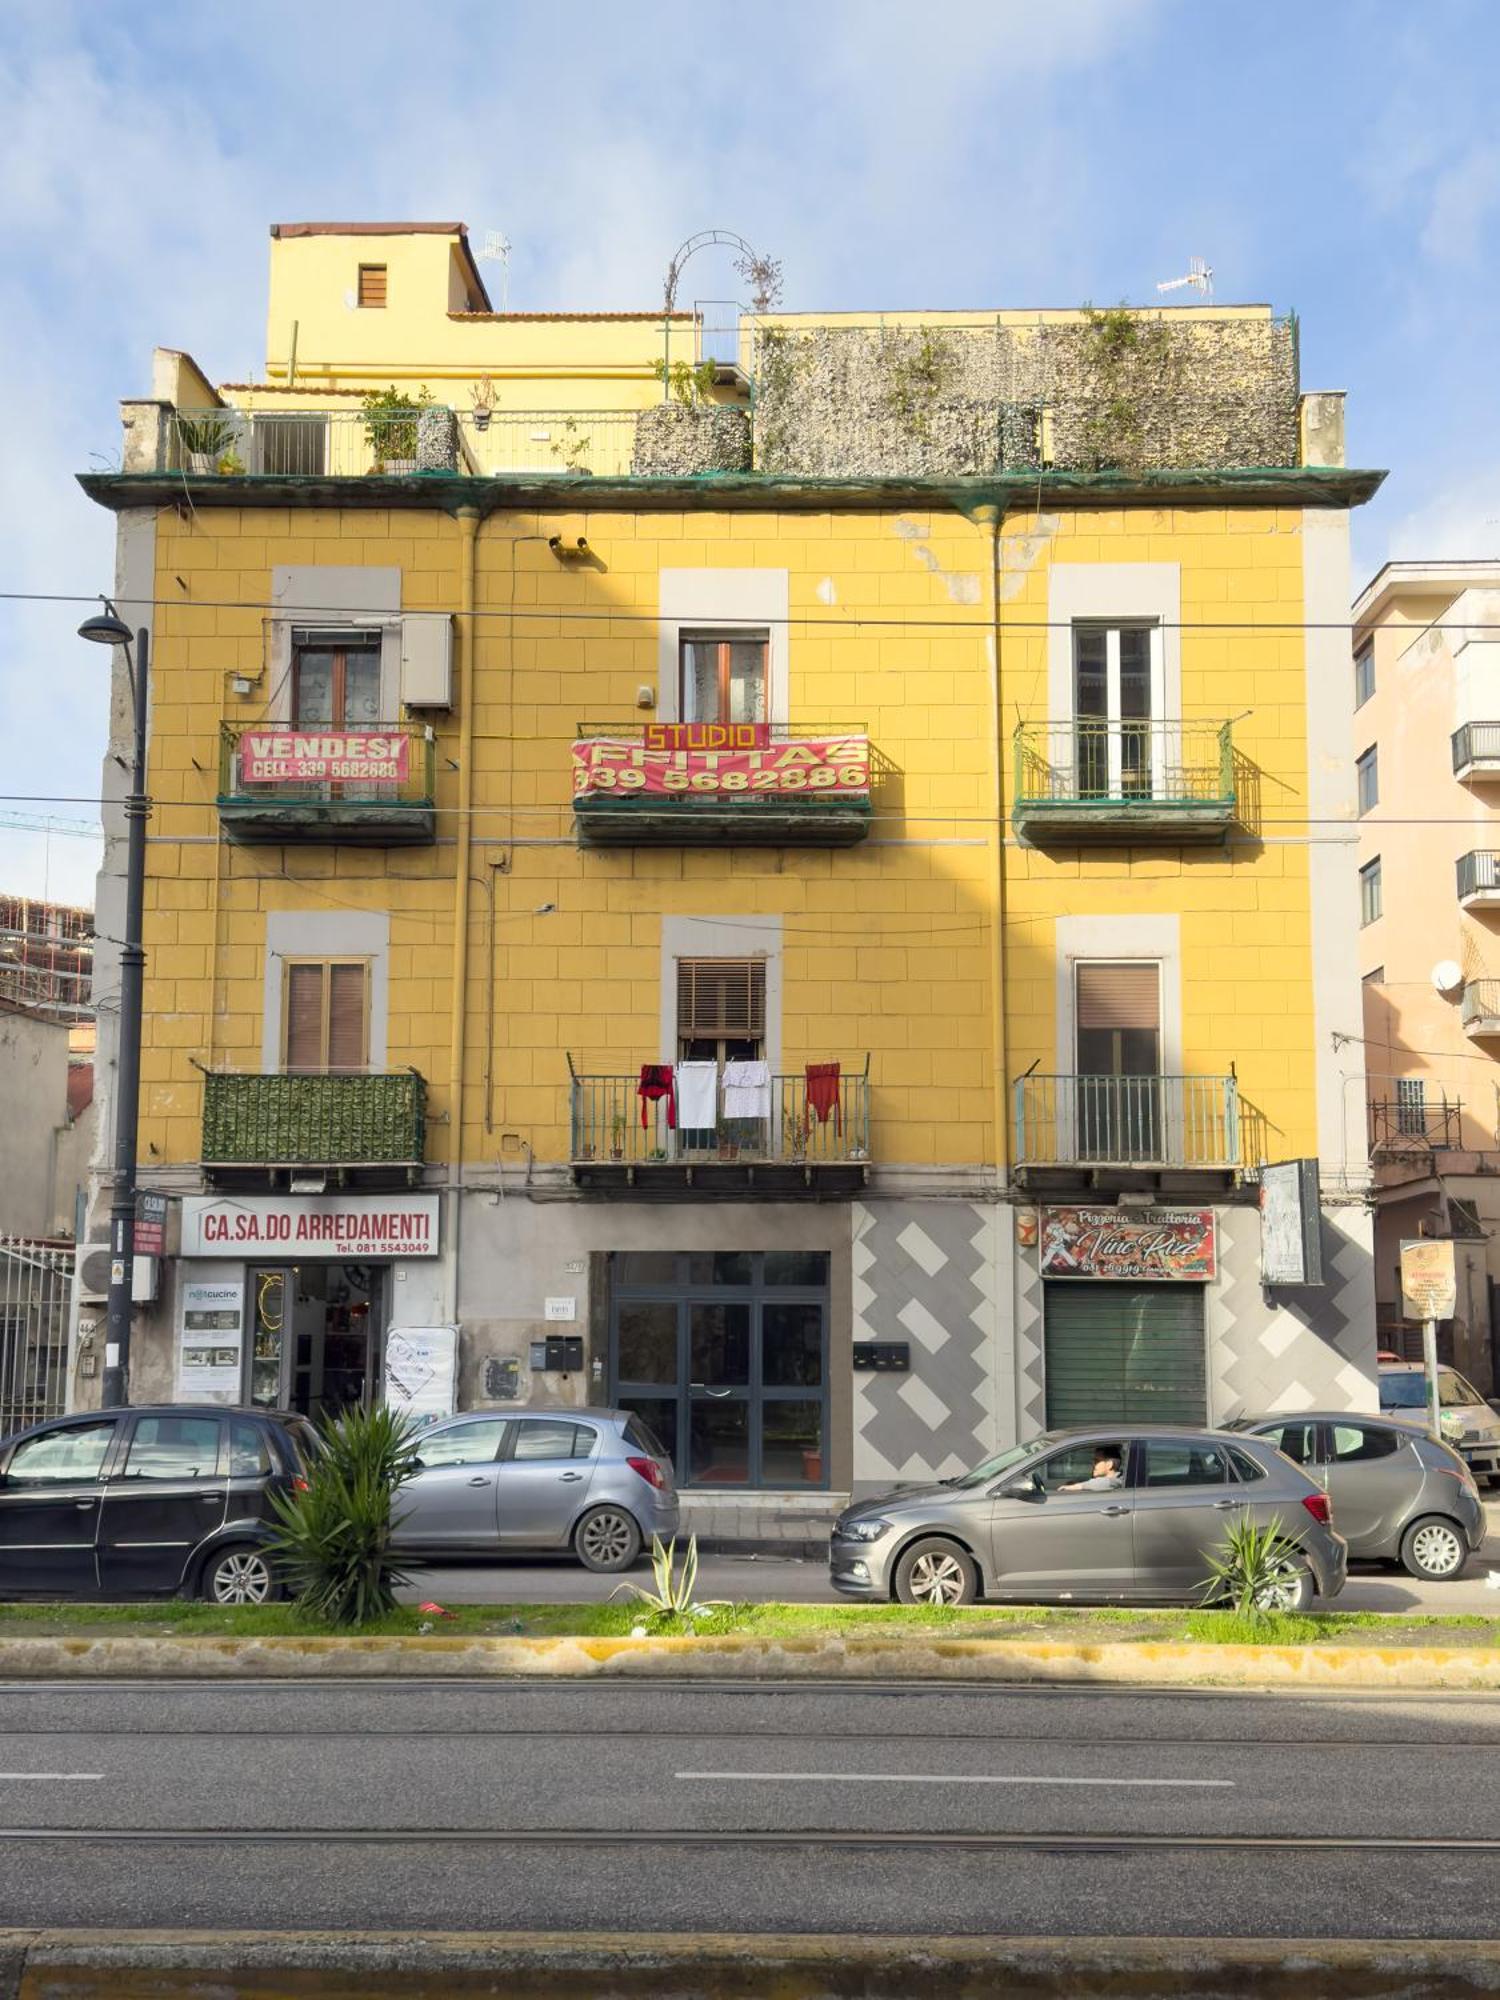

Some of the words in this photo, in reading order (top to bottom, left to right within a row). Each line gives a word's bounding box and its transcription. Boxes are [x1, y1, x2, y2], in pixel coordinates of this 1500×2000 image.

[649, 724, 756, 749] STUDIO
[250, 738, 401, 759] VENDESI
[253, 761, 292, 778] CELL.
[298, 761, 326, 777] 339
[331, 761, 397, 778] 5682886
[663, 765, 867, 791] 5682886
[204, 1214, 291, 1241] CA.SA.DO
[296, 1213, 430, 1241] ARREDAMENTI
[1078, 1210, 1129, 1225] Pizzeria
[1144, 1211, 1202, 1224] Trattoria
[336, 1243, 354, 1253] Tel.
[357, 1243, 376, 1253] 081
[381, 1243, 429, 1253] 5543049
